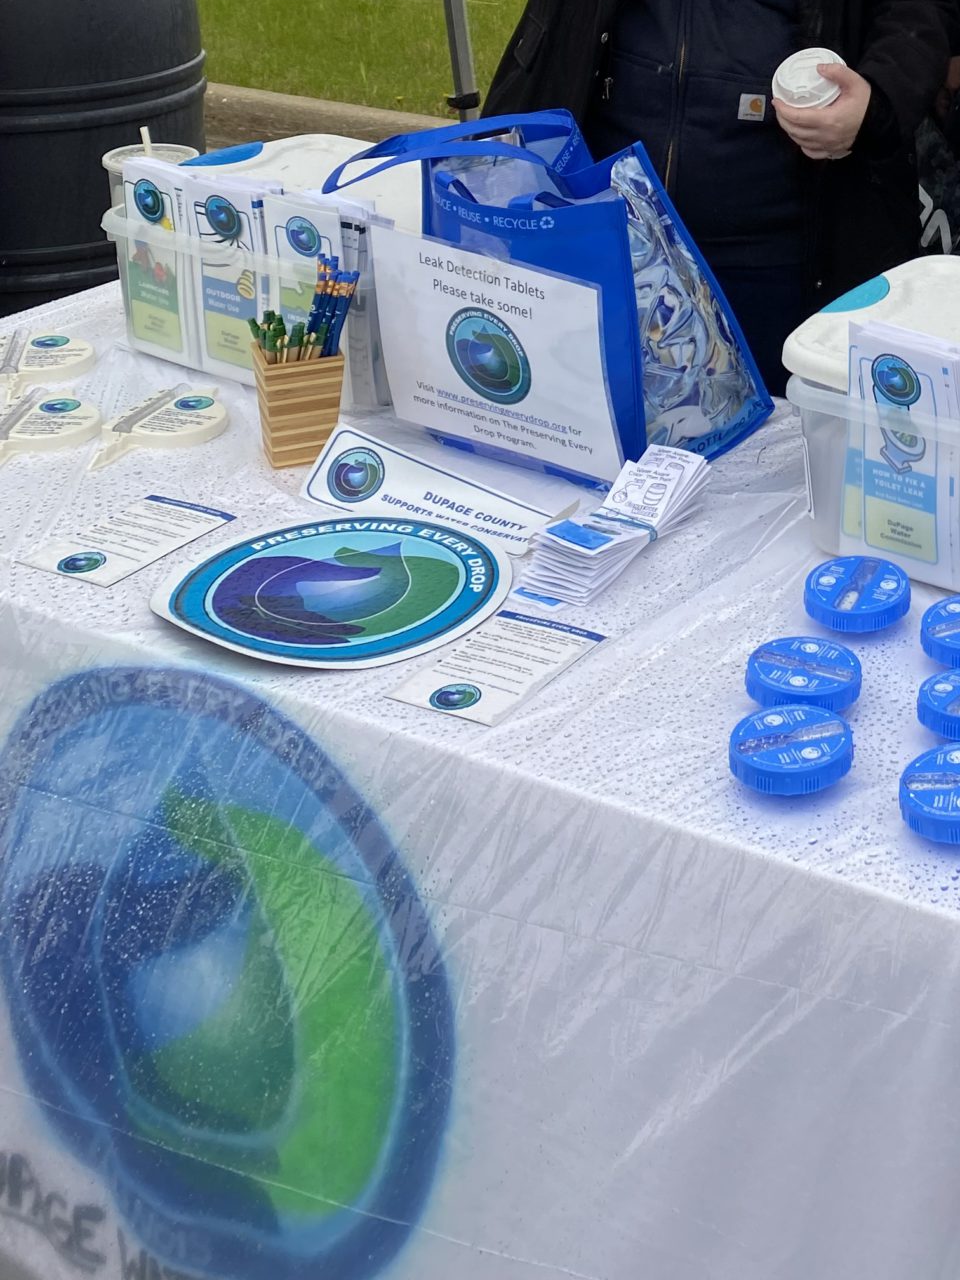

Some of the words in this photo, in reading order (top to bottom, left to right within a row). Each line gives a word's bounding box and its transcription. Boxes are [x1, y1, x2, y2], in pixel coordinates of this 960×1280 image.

[458, 206, 482, 224] REUSE
[493, 215, 538, 230] RECYCLE
[206, 287, 241, 303] OUTDOOR
[419, 252, 444, 269] Leak
[446, 260, 501, 287] Detection
[503, 276, 545, 300] Tablets
[433, 278, 468, 300] Please
[470, 290, 494, 308] take
[497, 304, 533, 320] some!
[484, 313, 508, 332] EVERY
[508, 332, 525, 357] DROP
[413, 395, 435, 407] more
[437, 398, 487, 422] information
[489, 417, 500, 426] on
[502, 420, 519, 432] The
[520, 425, 567, 447] Preserving
[568, 439, 593, 455] Every
[416, 380, 436, 393] Visit
[437, 387, 568, 434] www.preservingeverydrop.org
[568, 426, 582, 436] for
[473, 424, 495, 439] Drop
[497, 431, 537, 449] Program.
[872, 468, 891, 478] HOW
[892, 473, 903, 482] TO
[905, 476, 918, 486] FIX
[874, 478, 901, 492] TOILET
[903, 486, 924, 498] LEAK
[381, 493, 434, 517] SUPPORTS
[471, 524, 530, 543] CONSERVAT
[423, 491, 474, 516] DUPAGE
[474, 511, 528, 532] COUNTY
[250, 521, 415, 551] PRESERVING
[417, 527, 478, 557] EVERY
[467, 554, 486, 593] DROP
